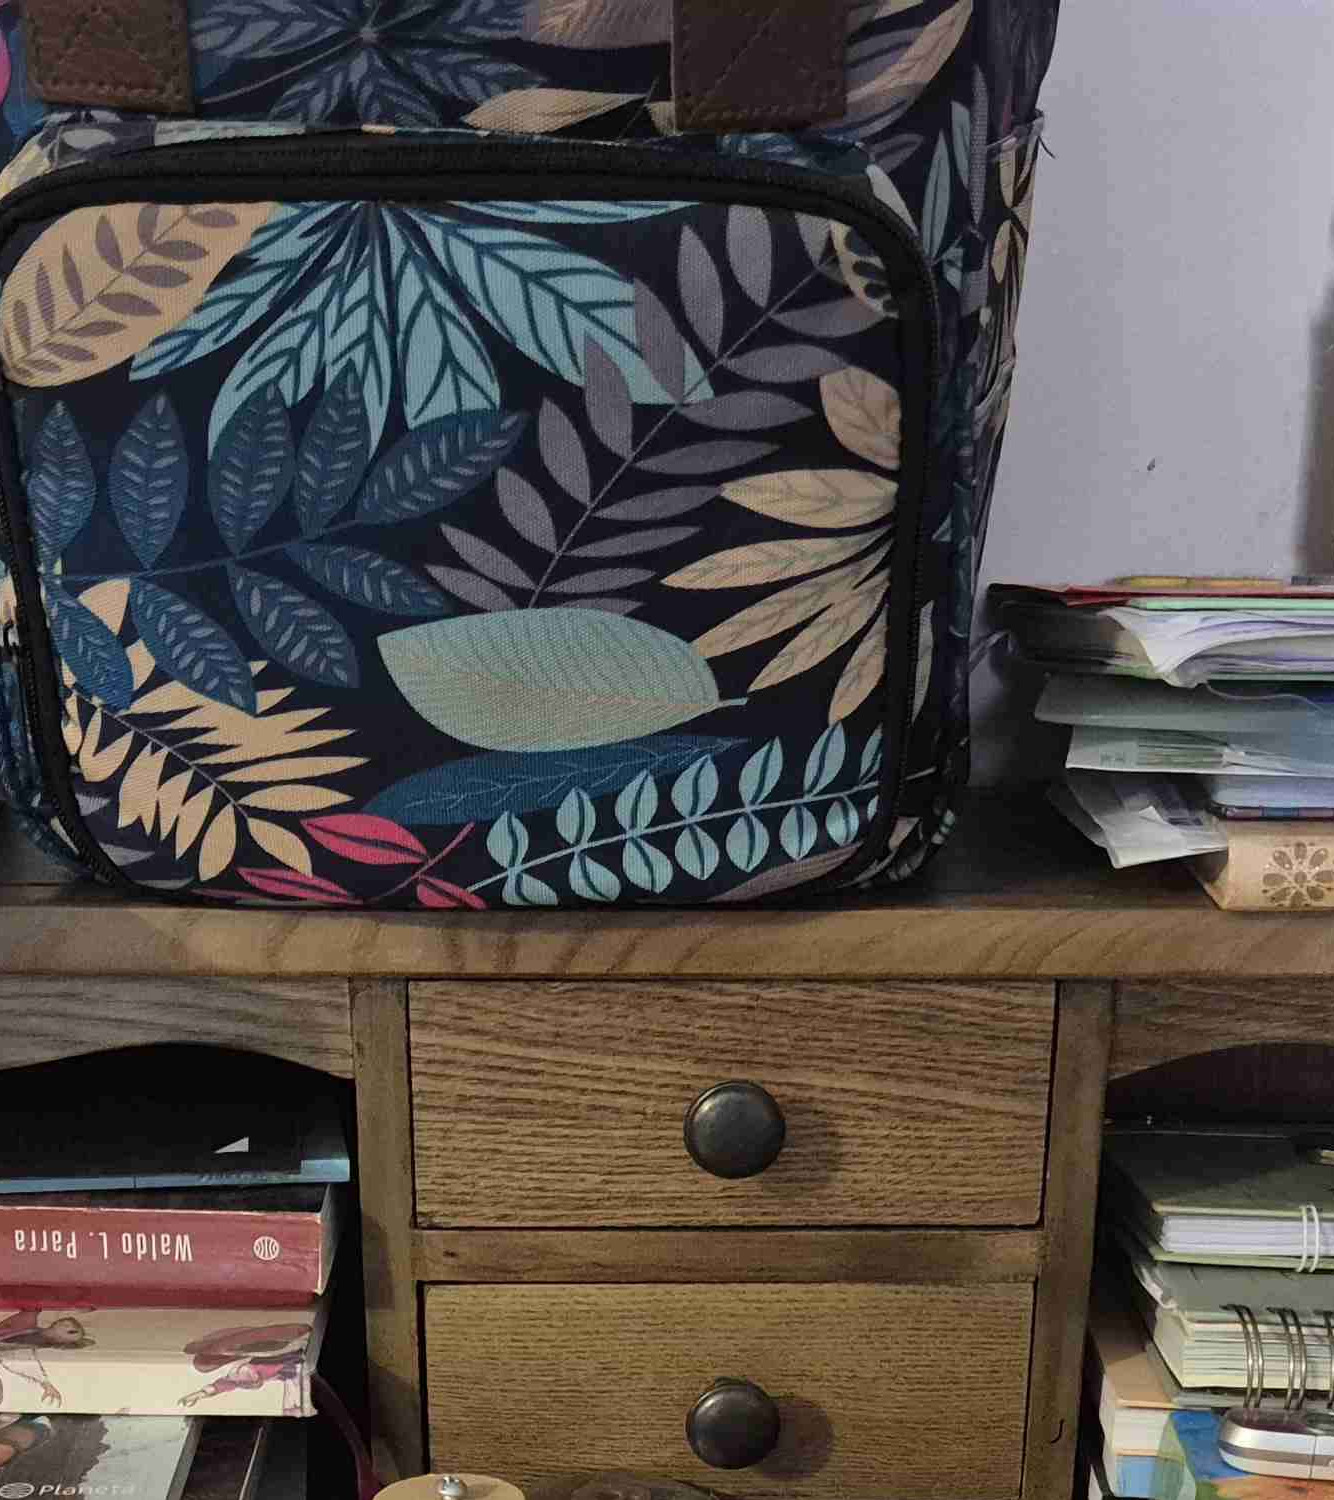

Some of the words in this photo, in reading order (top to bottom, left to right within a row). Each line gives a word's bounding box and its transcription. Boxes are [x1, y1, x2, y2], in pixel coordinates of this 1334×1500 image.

[14, 1228, 77, 1260] Parra
[88, 1230, 109, 1260] L.
[121, 1231, 194, 1262] Waldo
[38, 1482, 136, 1497] Planeta
